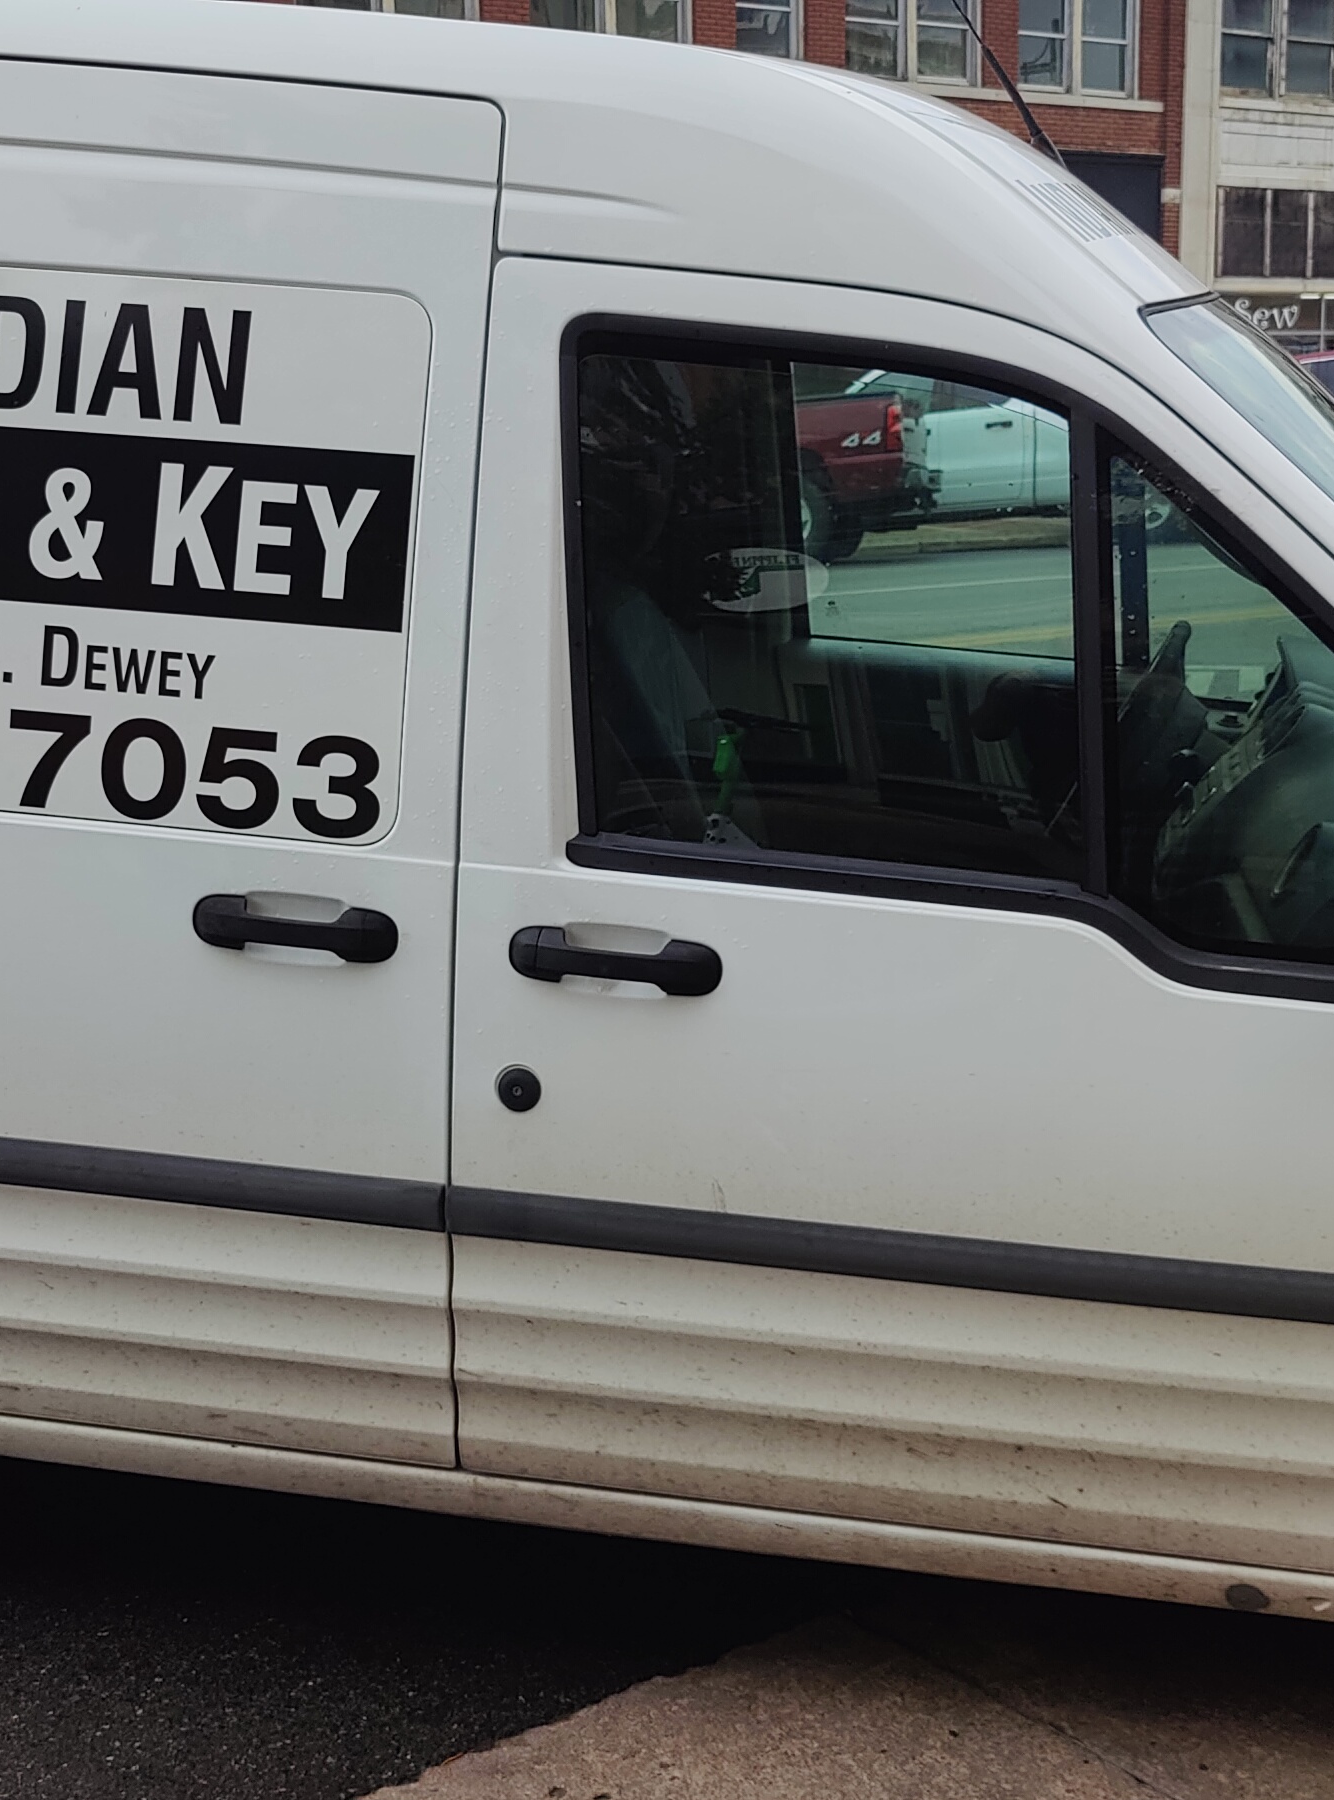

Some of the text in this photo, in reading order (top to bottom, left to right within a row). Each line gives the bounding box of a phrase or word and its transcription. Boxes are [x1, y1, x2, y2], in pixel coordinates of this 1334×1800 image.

[1234, 298, 1301, 330] Sew
[28, 467, 104, 582] &
[151, 462, 381, 600] KEY
[40, 624, 217, 701] DEWEY
